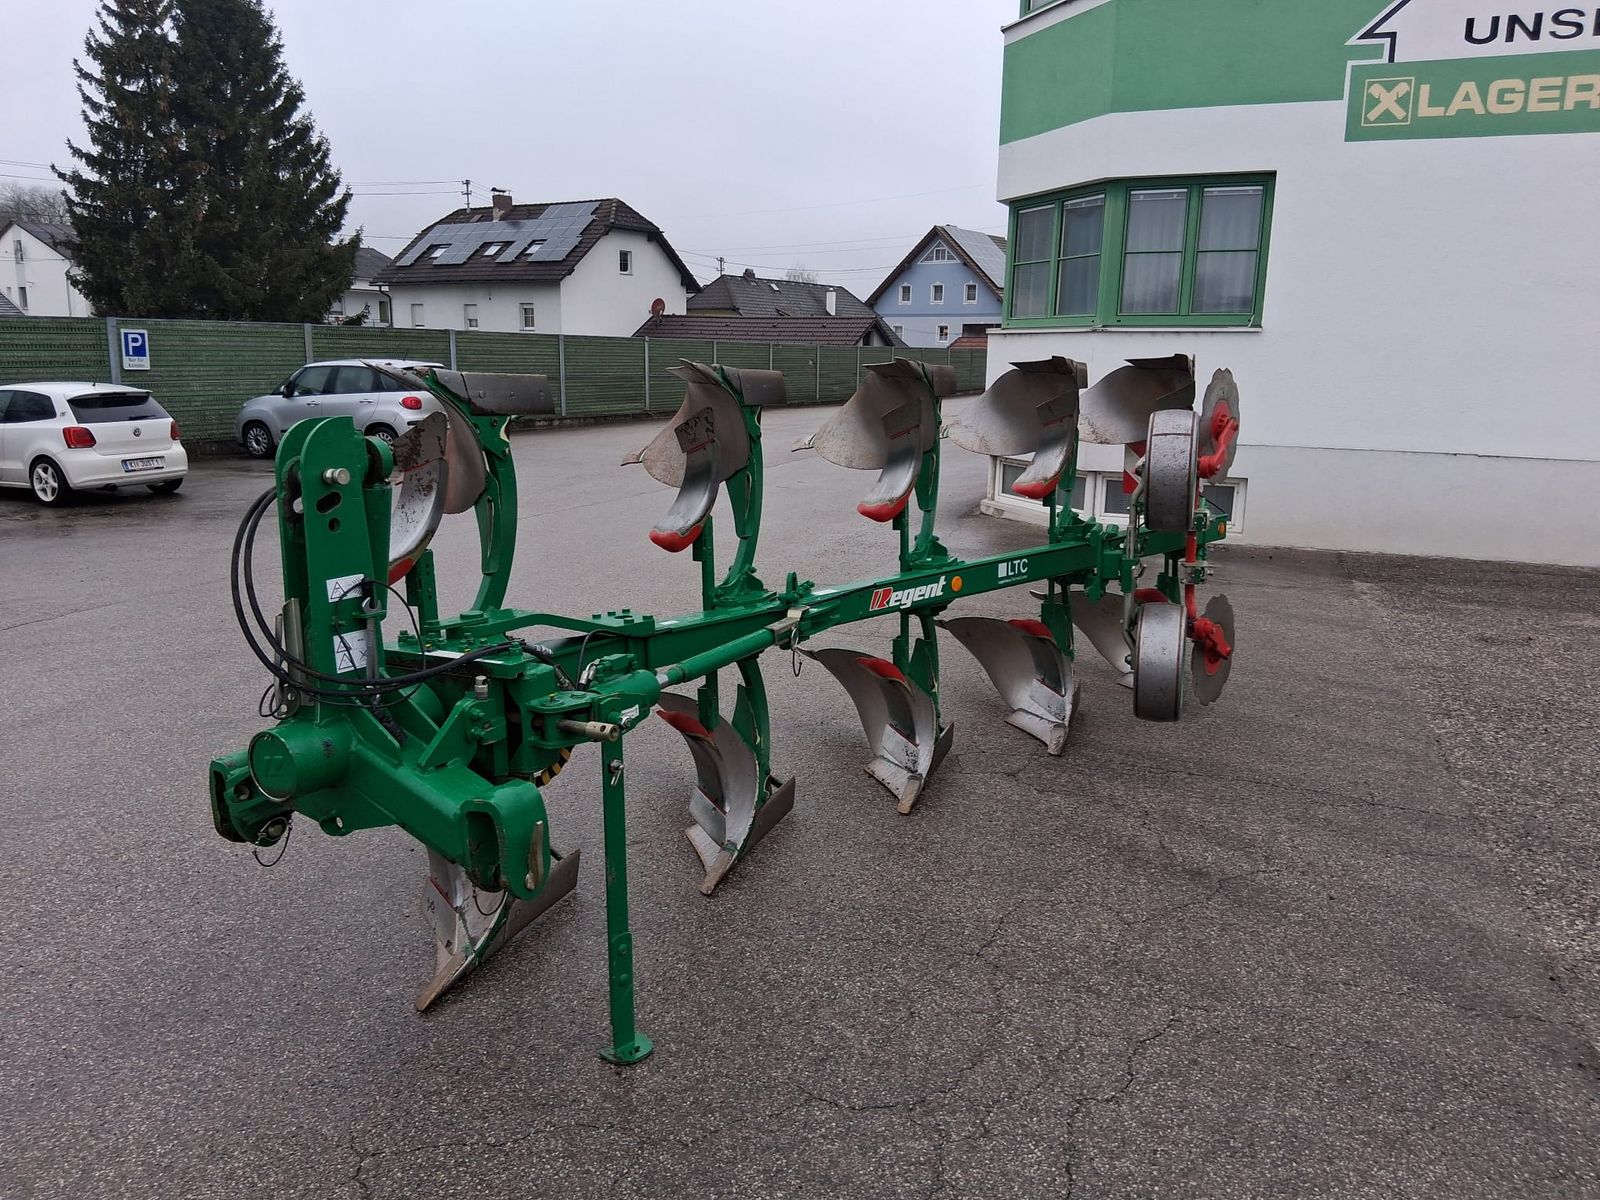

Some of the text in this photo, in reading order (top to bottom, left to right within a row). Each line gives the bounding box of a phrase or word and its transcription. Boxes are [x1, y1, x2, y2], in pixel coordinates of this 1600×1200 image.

[1464, 8, 1600, 45] UNS
[1417, 74, 1600, 117] LAGER
[128, 333, 142, 355] P
[1008, 558, 1028, 576] LTC
[869, 575, 946, 611] Regent
